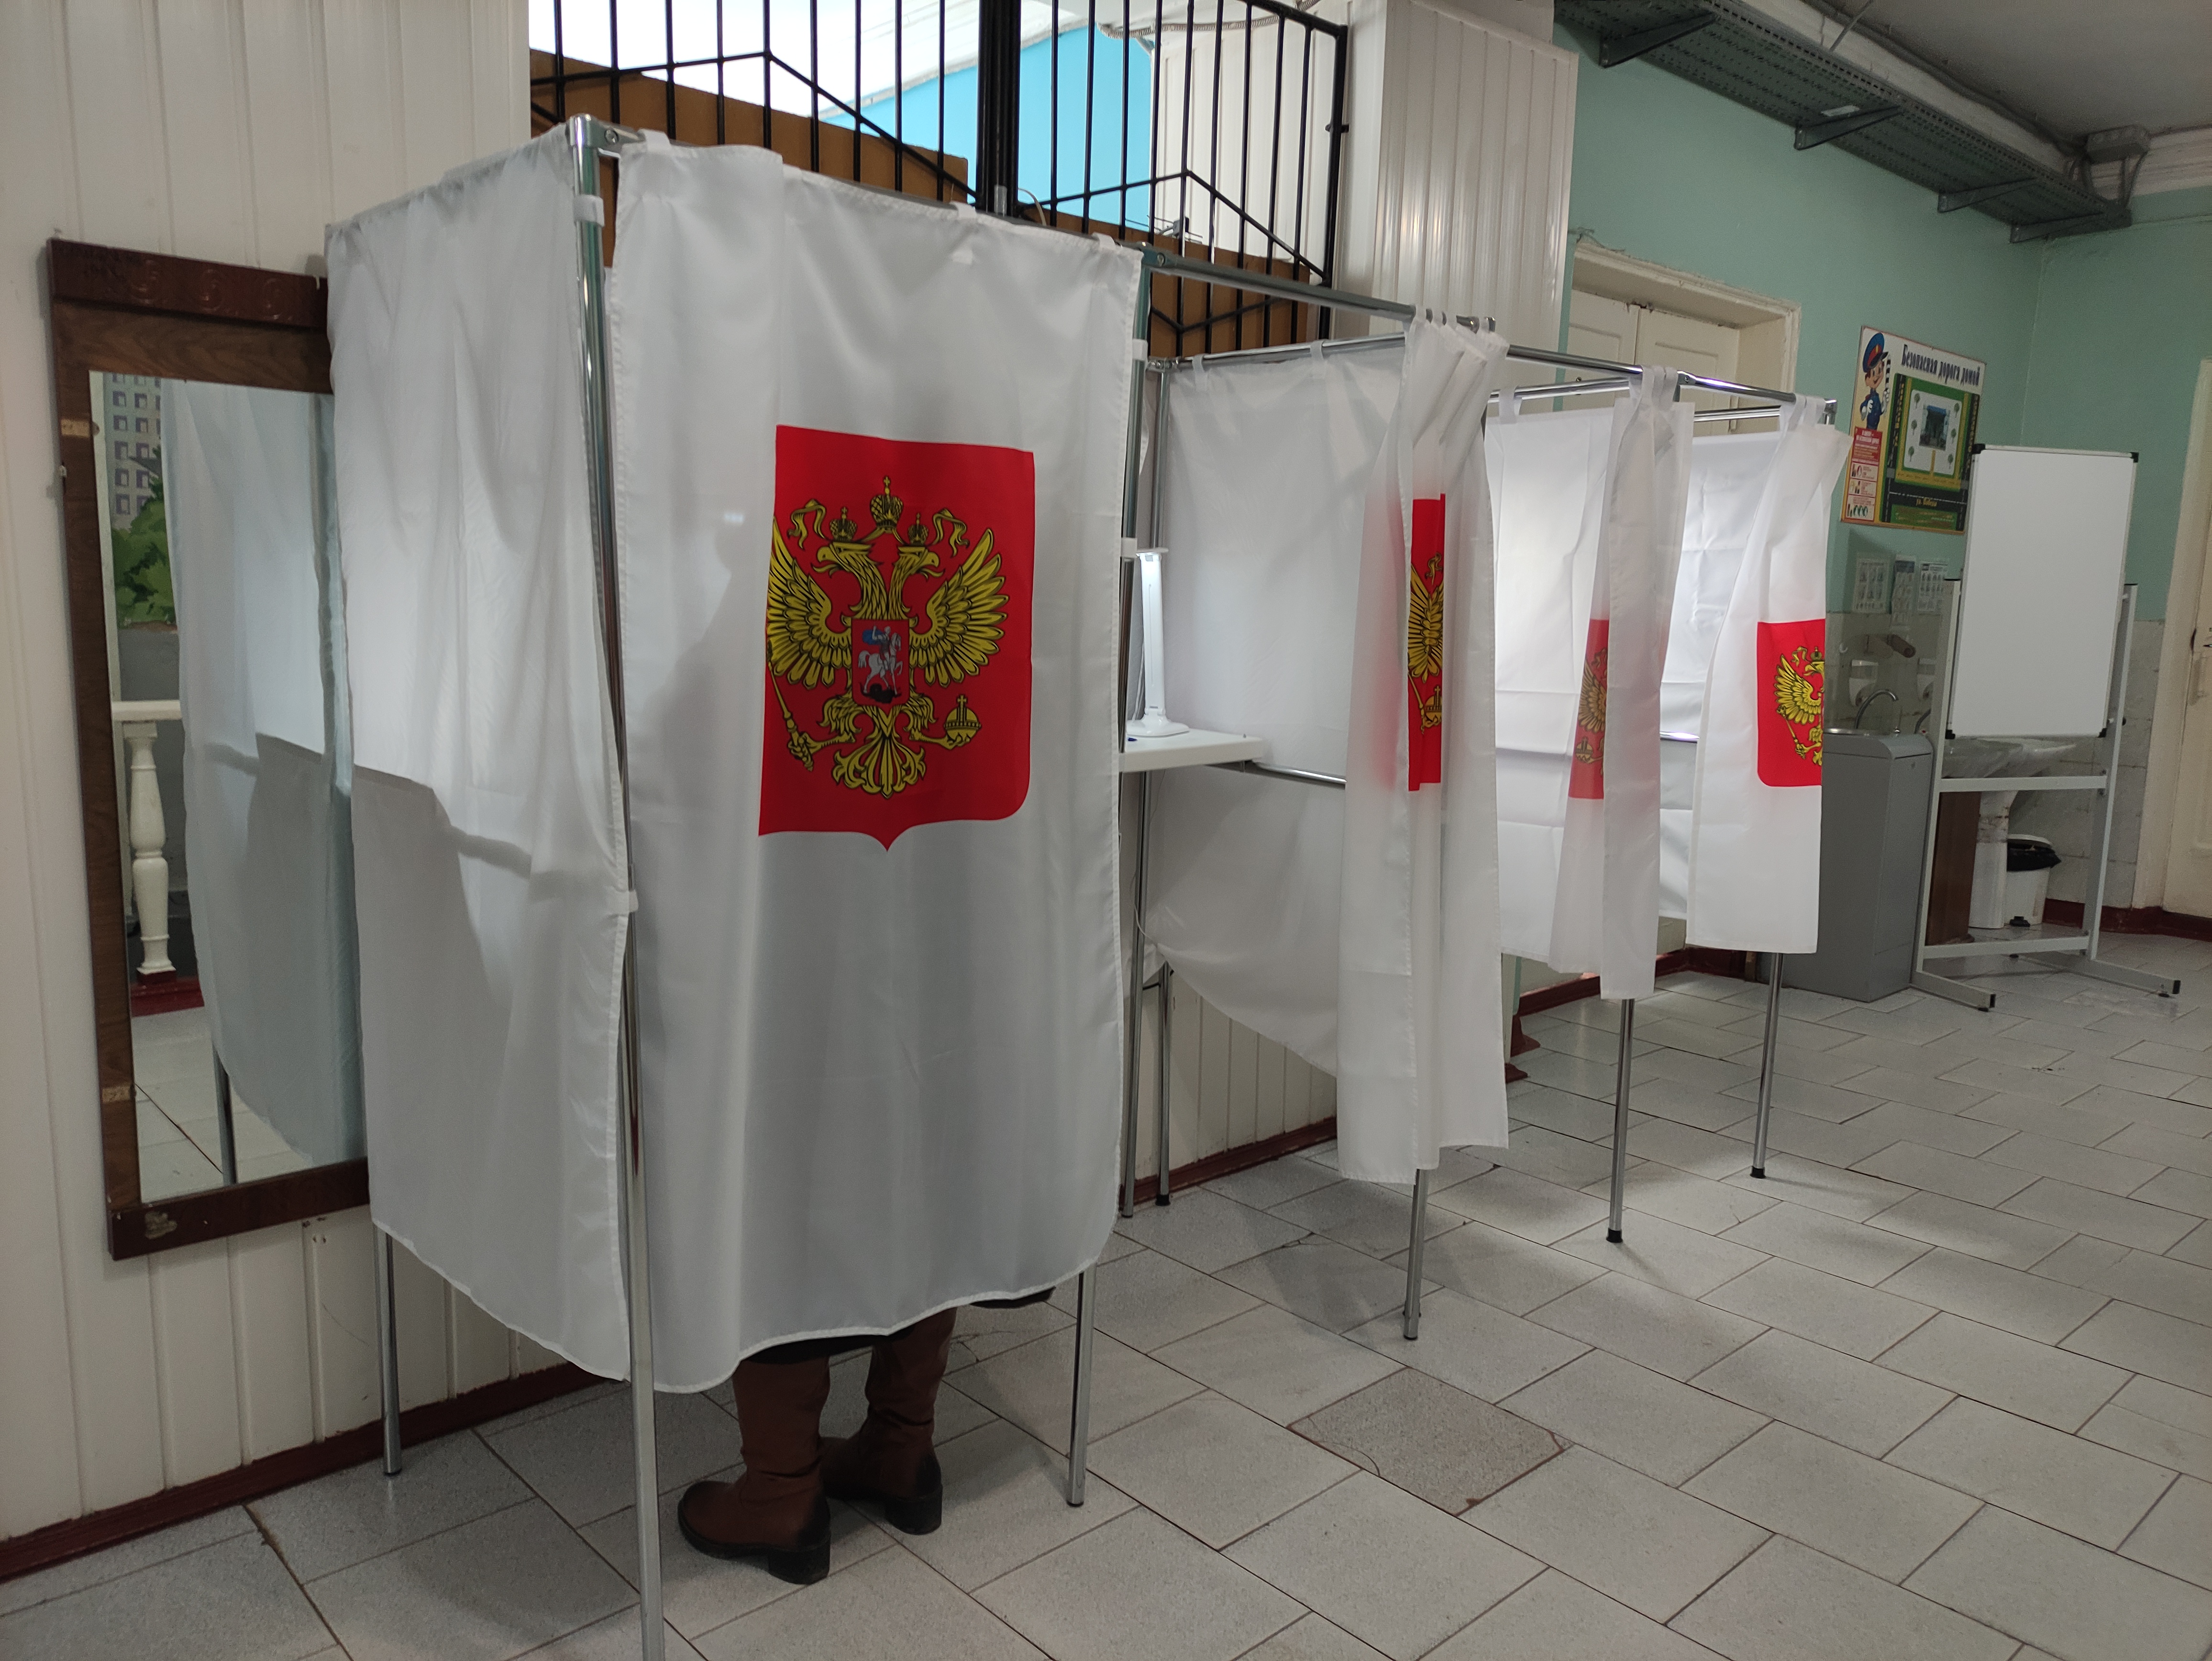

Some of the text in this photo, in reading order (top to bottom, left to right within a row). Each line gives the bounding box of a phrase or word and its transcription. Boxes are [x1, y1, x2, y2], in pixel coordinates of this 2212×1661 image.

[1902, 344, 1980, 386] Безопасная дорога домой
